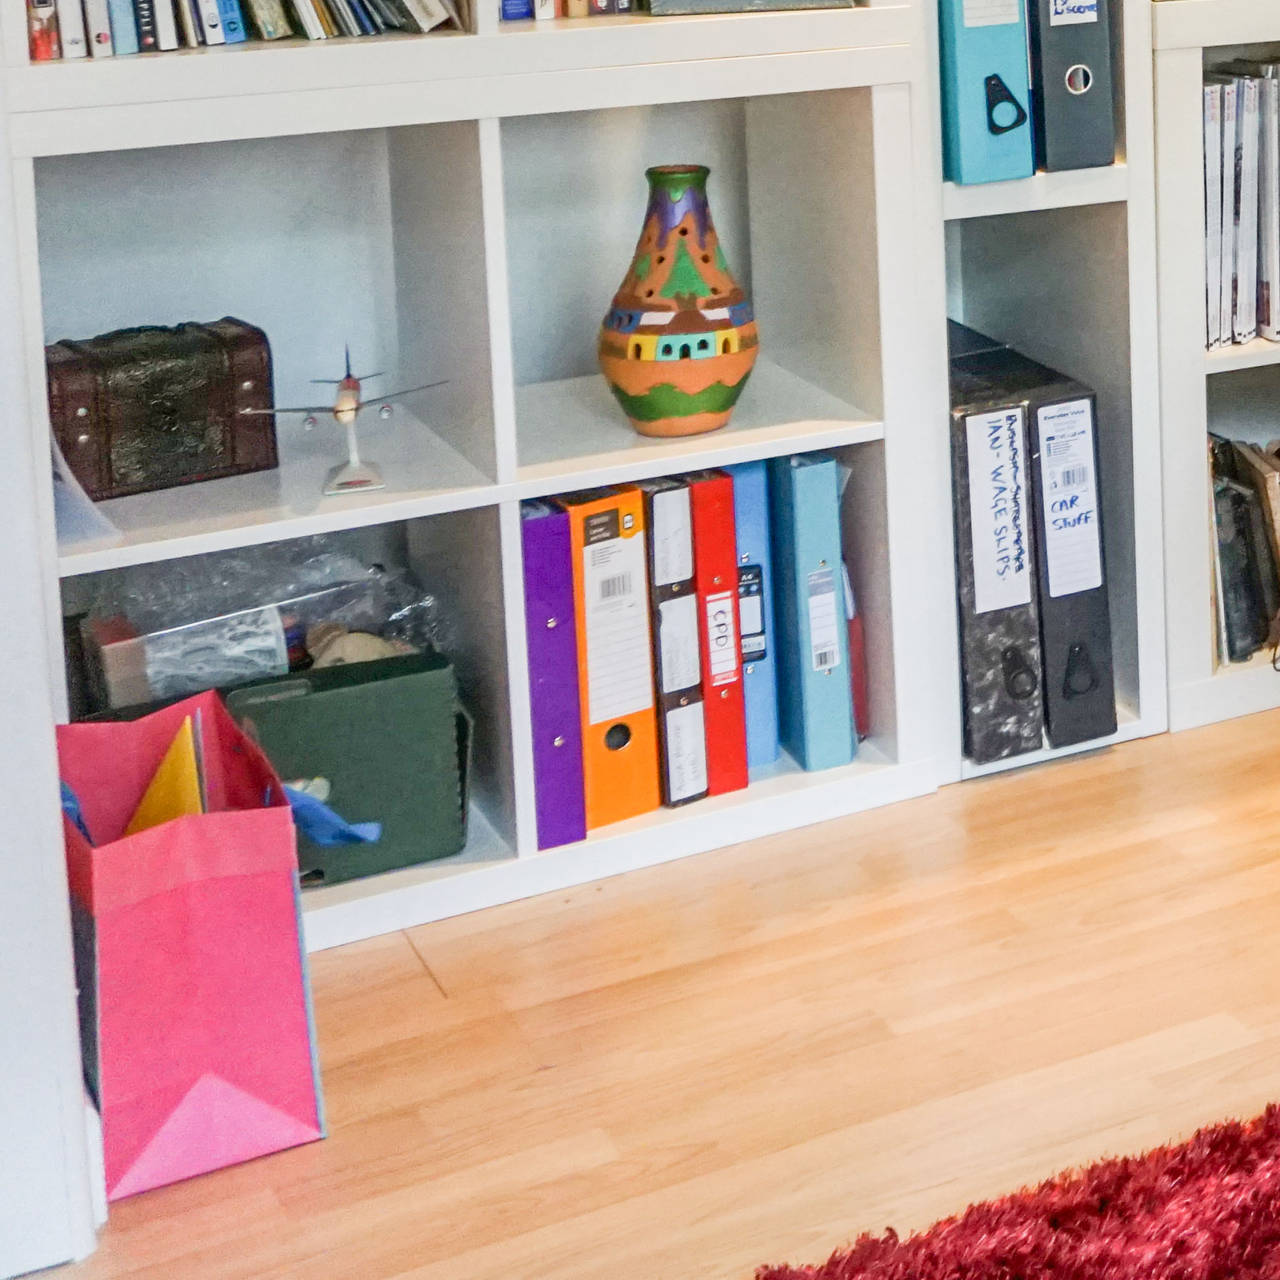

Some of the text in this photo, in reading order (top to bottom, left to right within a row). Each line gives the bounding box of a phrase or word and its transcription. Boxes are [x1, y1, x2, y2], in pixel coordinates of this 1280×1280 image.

[991, 465, 1008, 520] WAGE
[1050, 495, 1080, 513] CAR
[1052, 510, 1094, 531] STUFF
[713, 609, 728, 648] CPD
